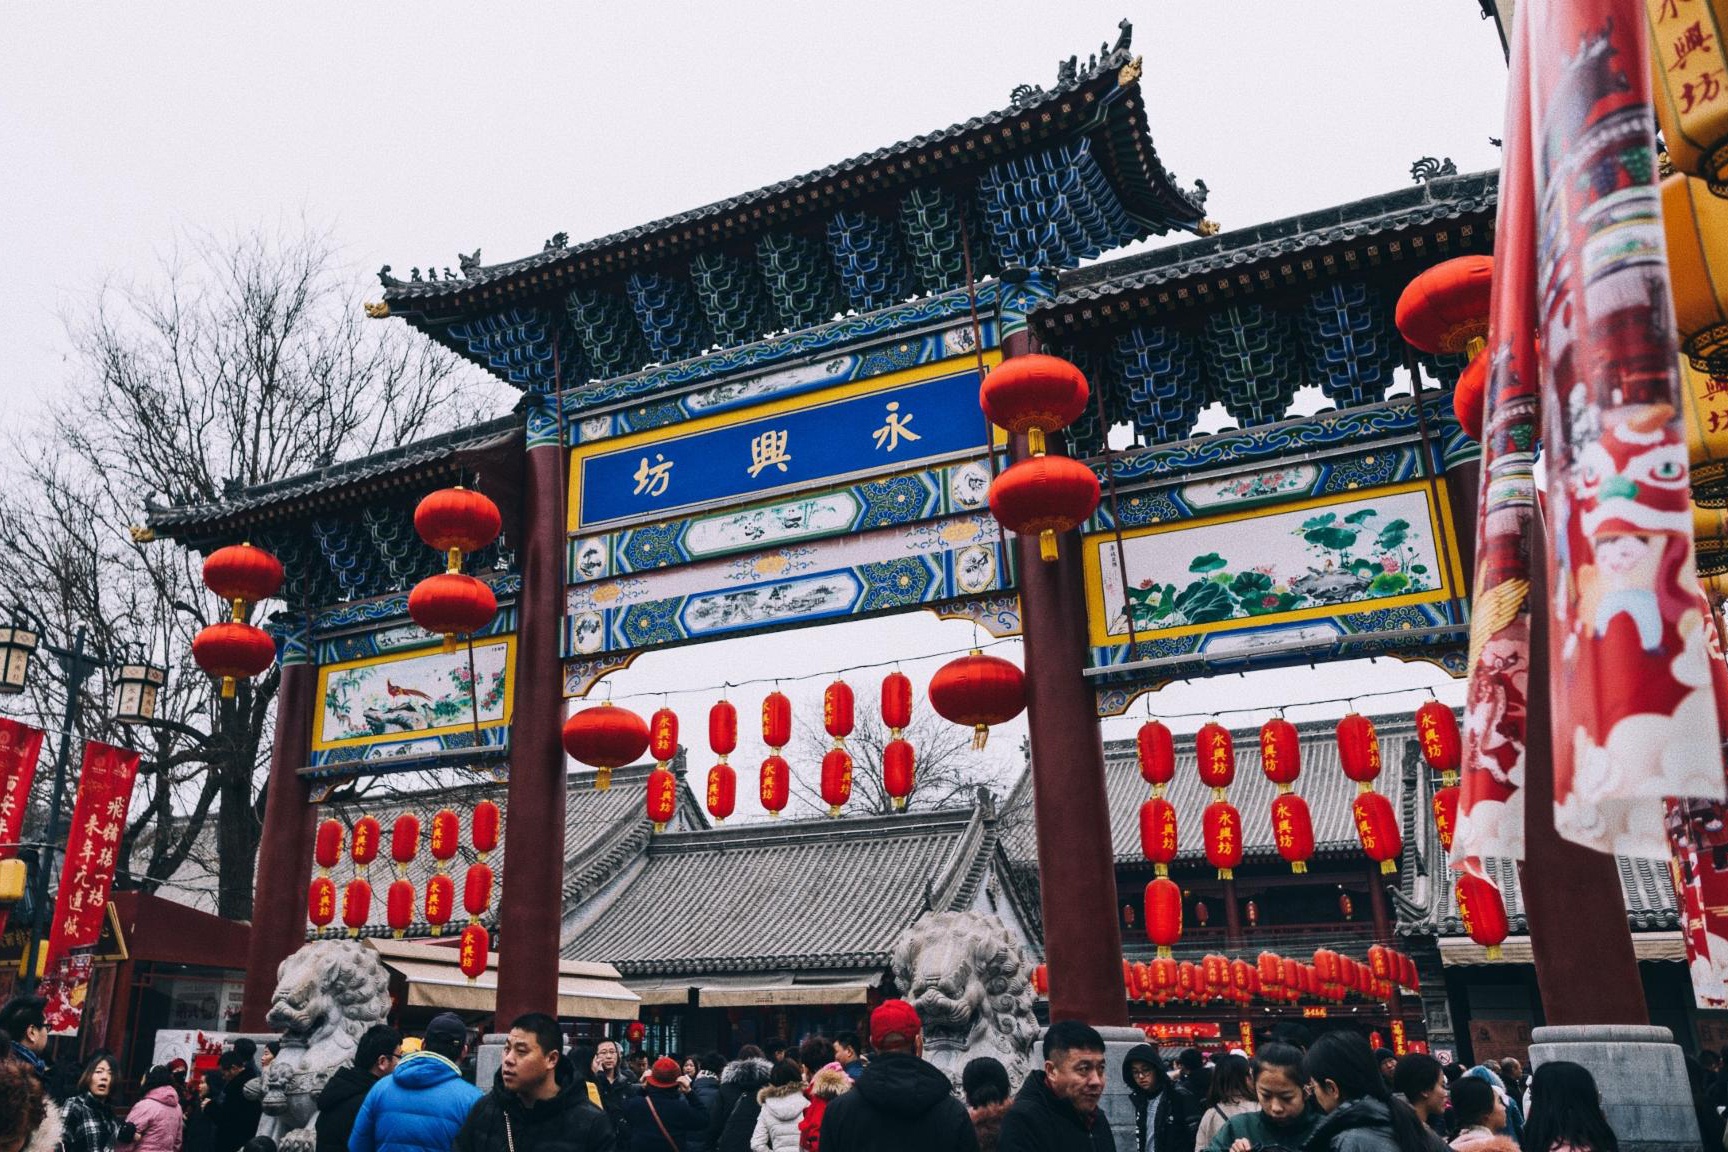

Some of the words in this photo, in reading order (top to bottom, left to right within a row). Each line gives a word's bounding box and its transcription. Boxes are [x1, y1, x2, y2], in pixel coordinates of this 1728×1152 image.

[657, 715, 670, 750] 永興坊
[1263, 729, 1277, 772] 永興坊
[1421, 713, 1442, 757] 永興坊
[1212, 734, 1227, 774] 永興坊
[659, 776, 673, 812] 永興坊
[707, 770, 719, 807] 永興坊
[762, 764, 775, 800] 永興坊
[1162, 809, 1175, 849] 永興坊
[1217, 811, 1232, 855] 永興坊
[1277, 804, 1293, 848] 永興坊
[1355, 806, 1375, 849] 永興坊
[462, 932, 474, 968] 永興坊
